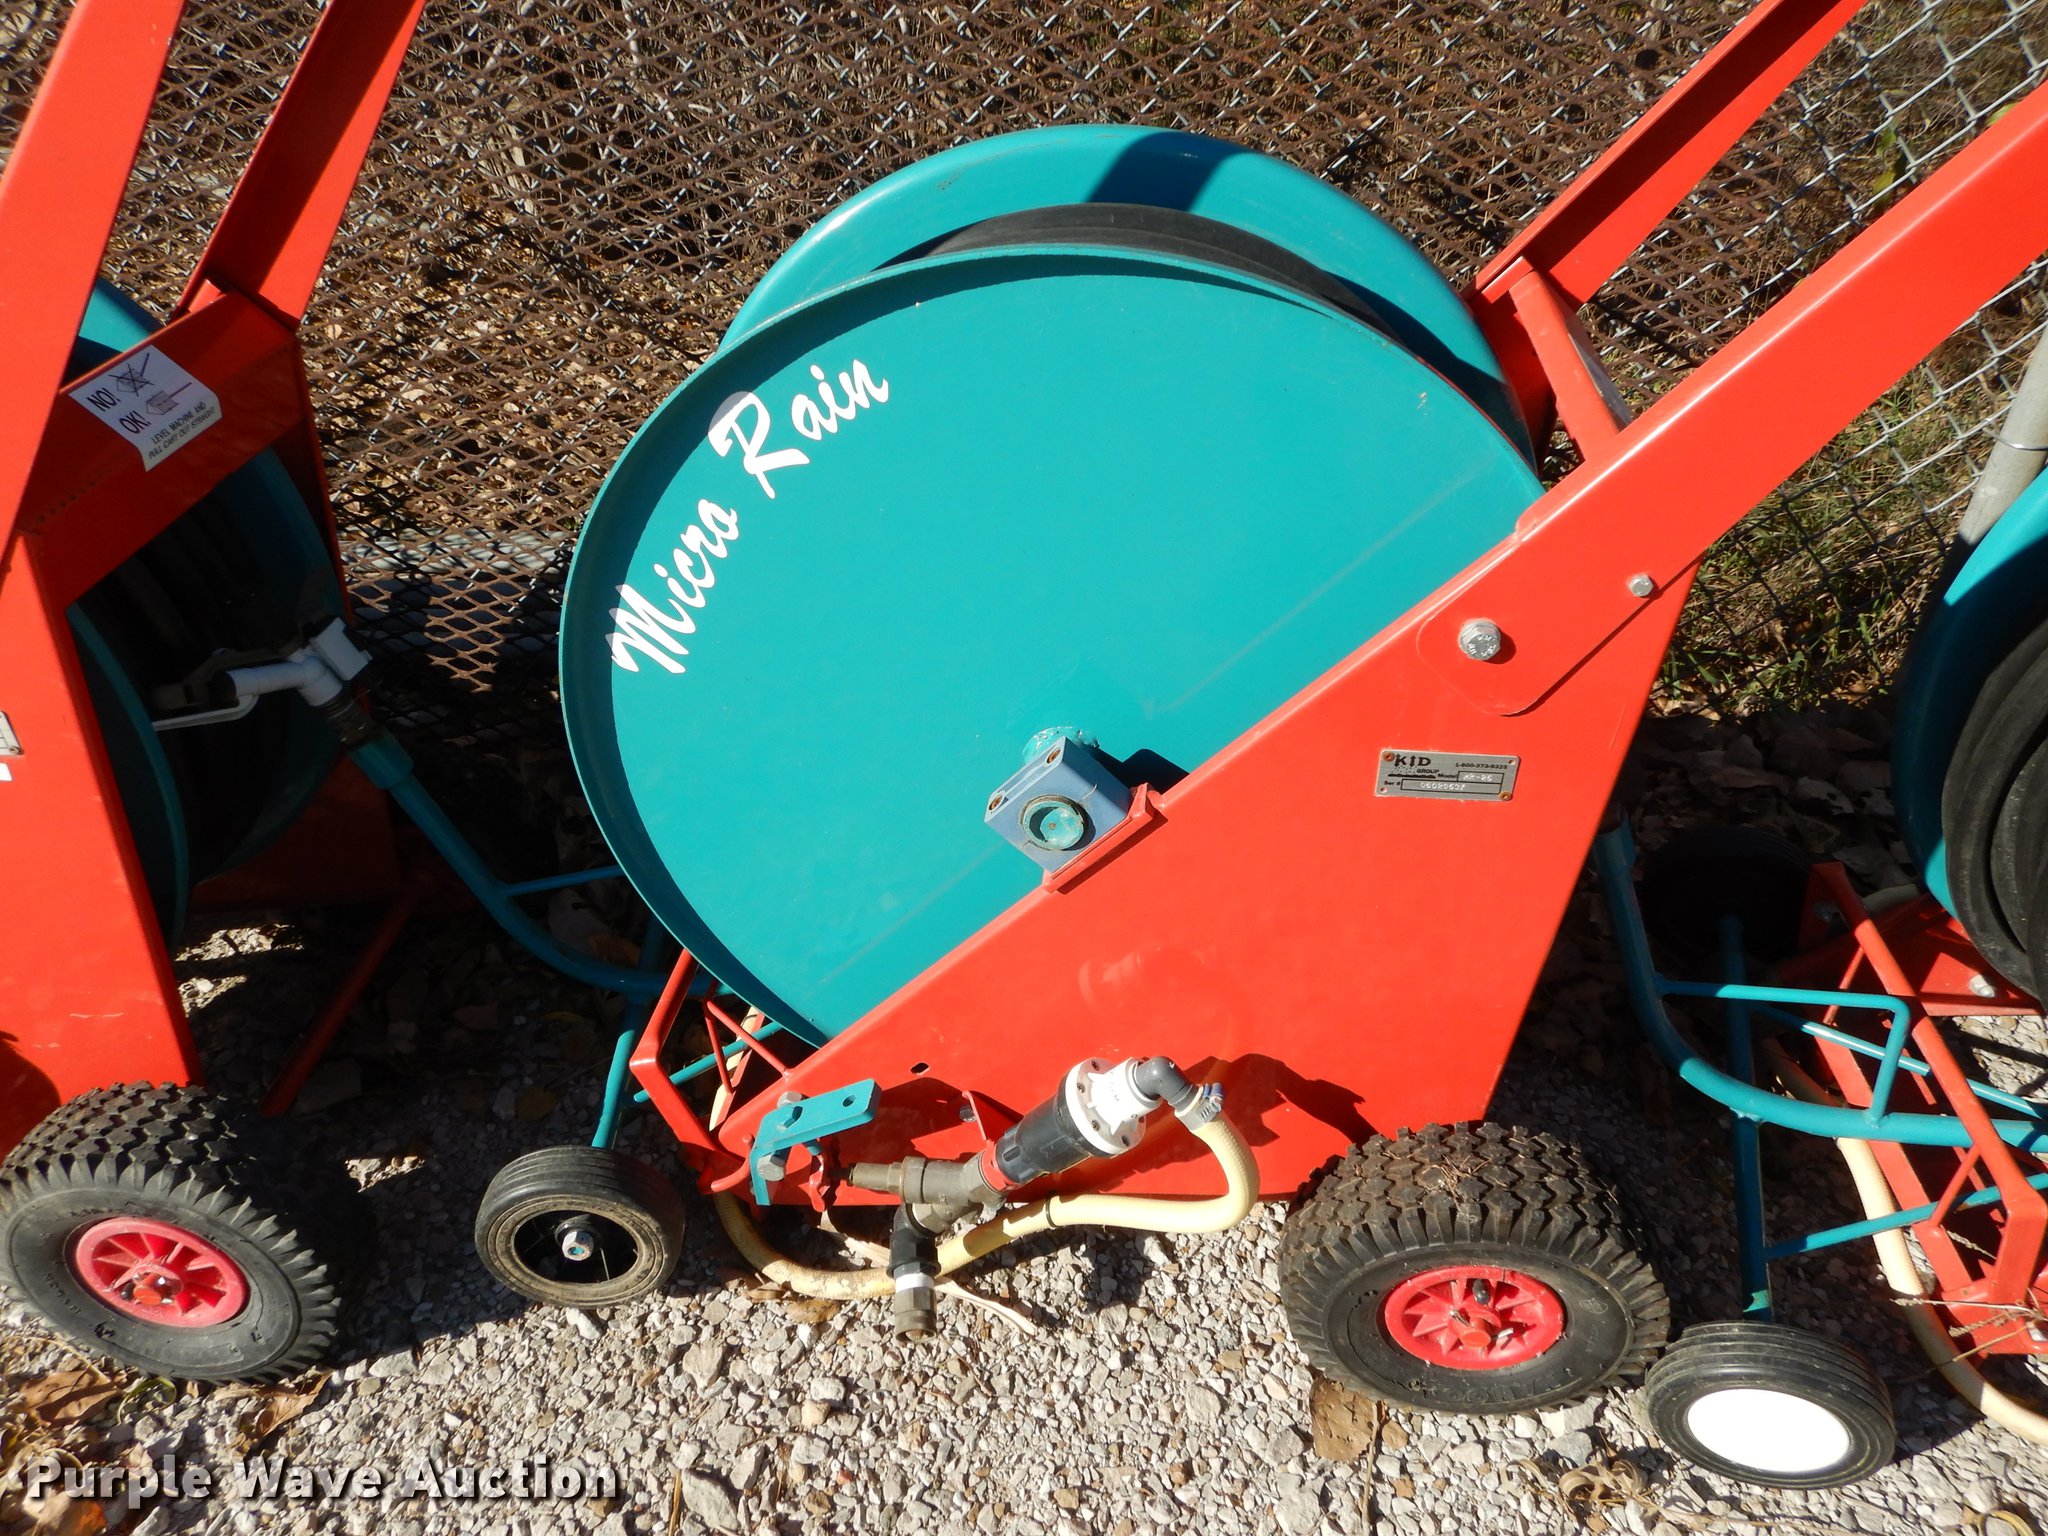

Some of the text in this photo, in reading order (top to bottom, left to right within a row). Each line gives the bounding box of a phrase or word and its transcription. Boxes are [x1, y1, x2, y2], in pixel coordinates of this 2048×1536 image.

[86, 387, 121, 412] NO!
[119, 410, 152, 434] OK!
[151, 402, 207, 444] LEVEL MACHINE AND
[605, 359, 889, 674] Micro Rain
[1394, 753, 1432, 768] KID
